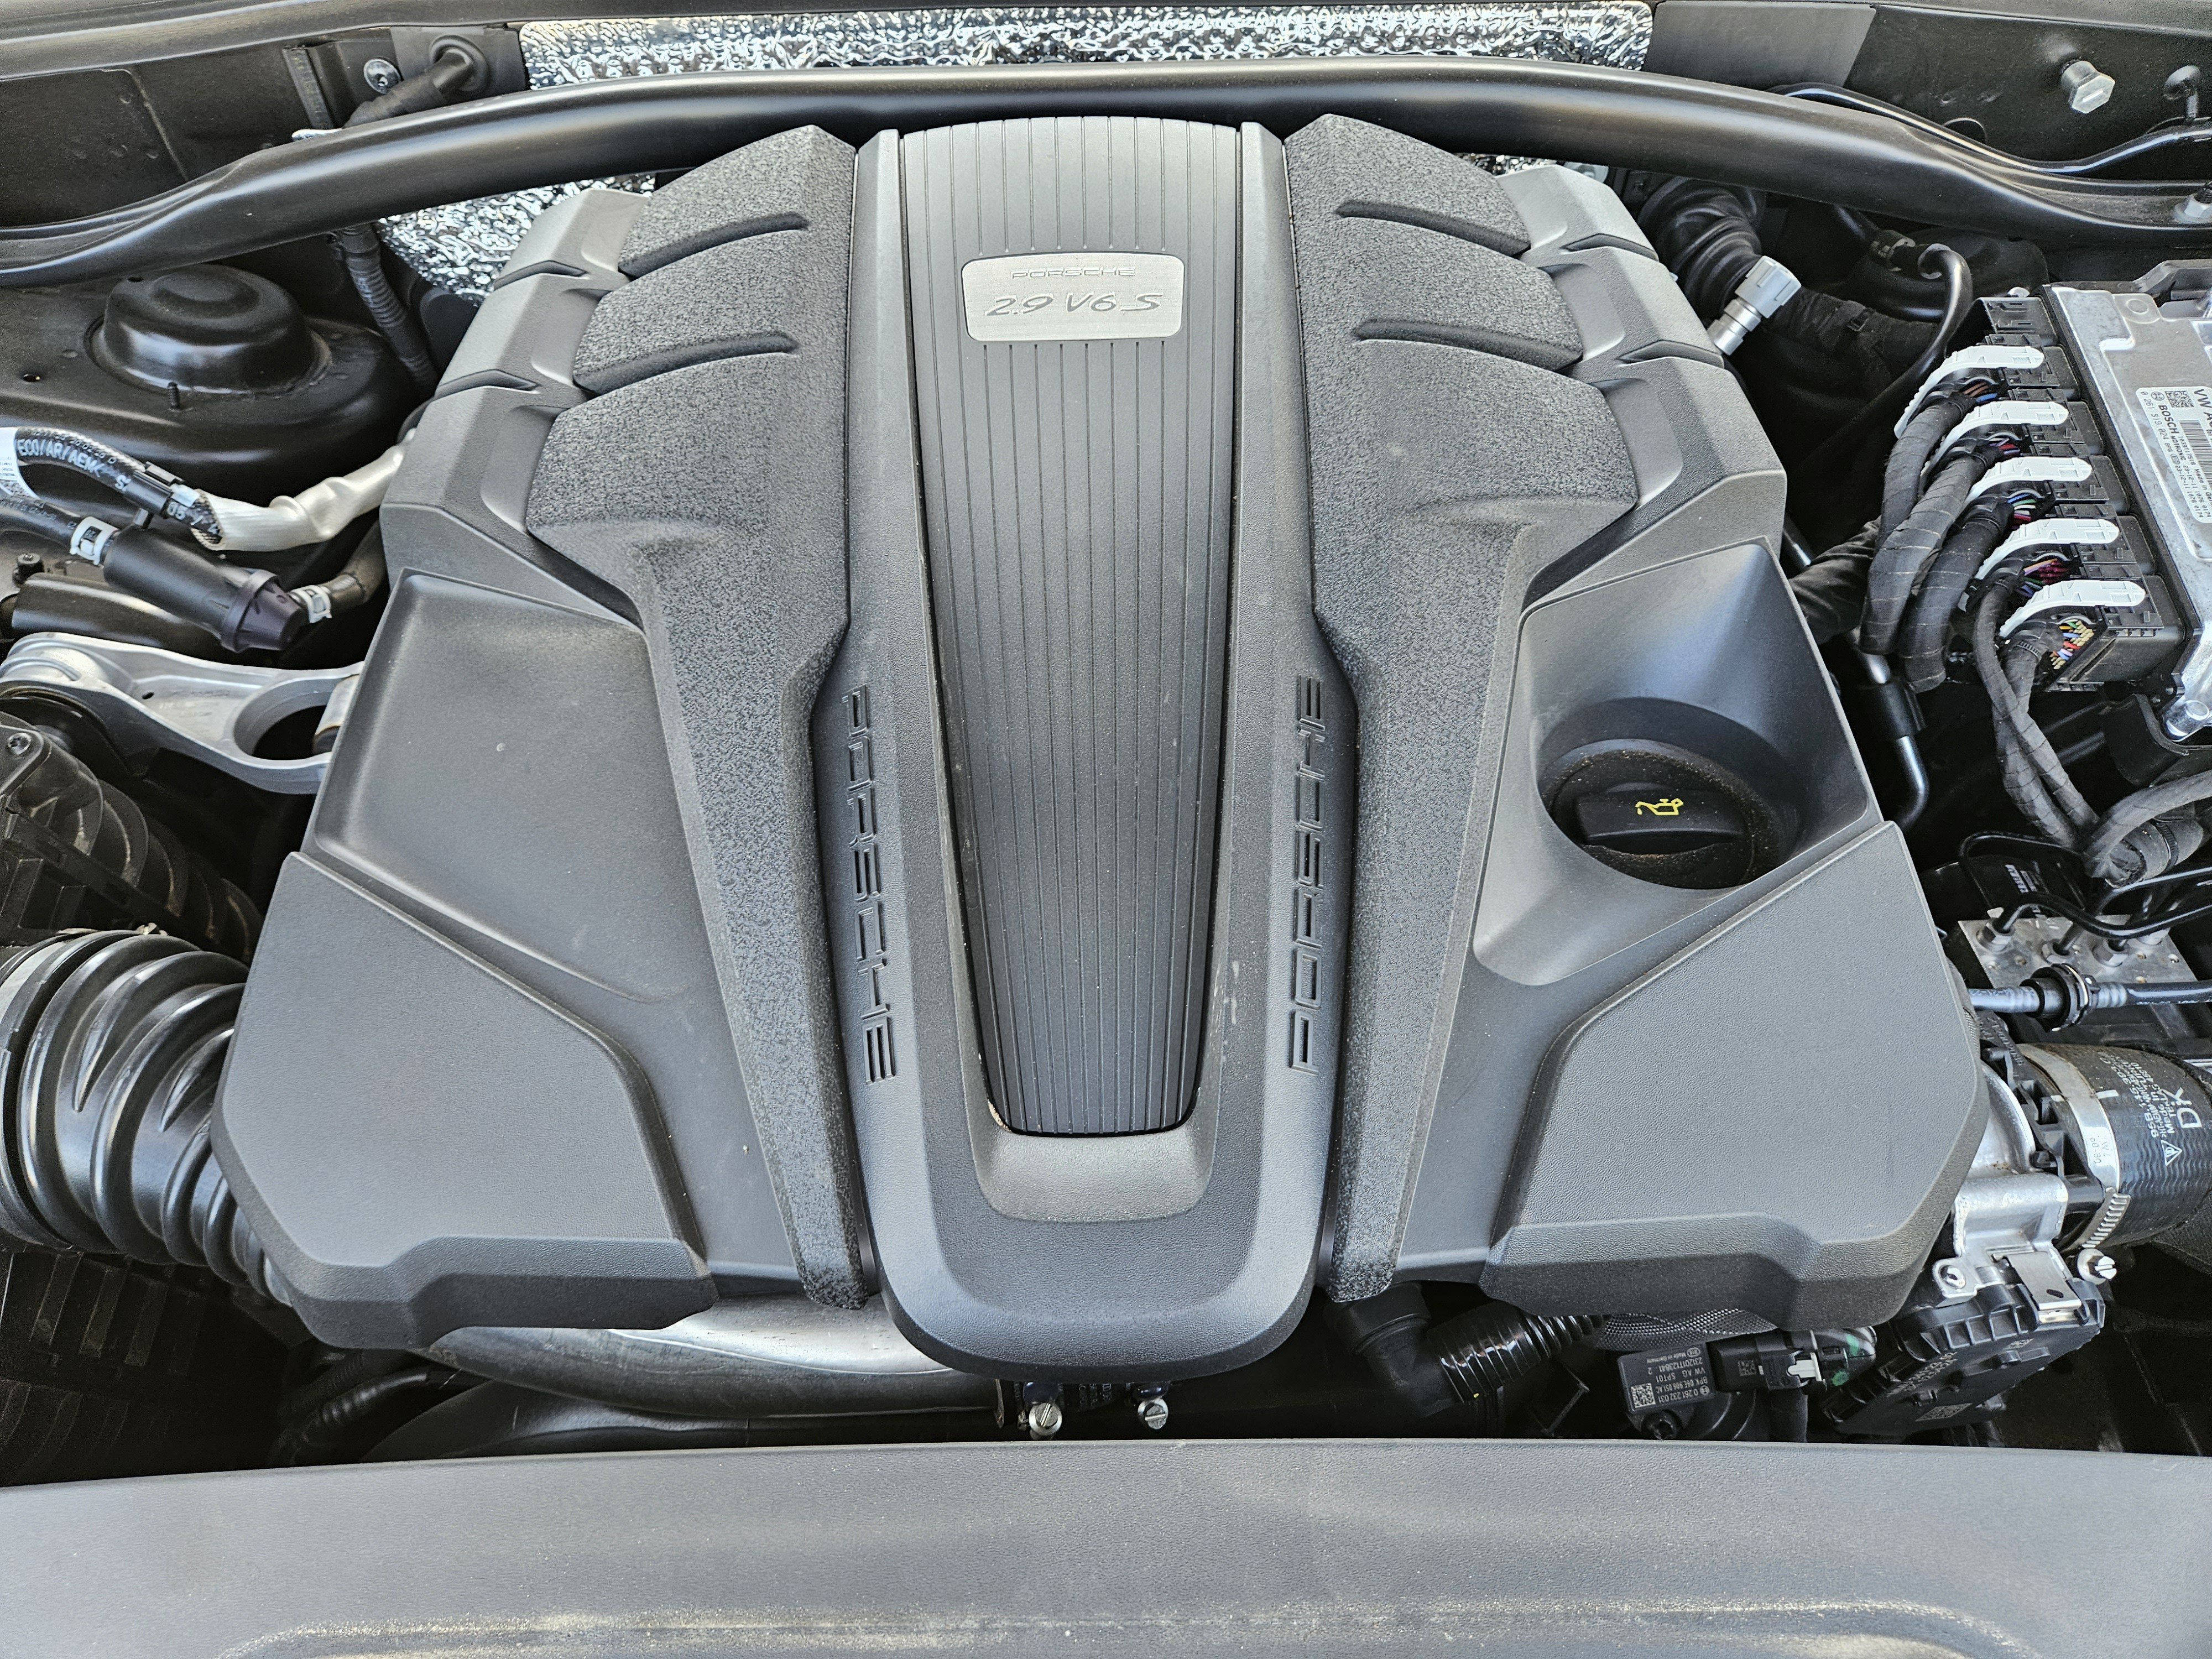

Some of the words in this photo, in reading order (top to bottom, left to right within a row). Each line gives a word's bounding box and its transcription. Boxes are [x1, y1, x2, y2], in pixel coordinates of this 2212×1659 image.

[1011, 267, 1135, 279] PORSCHE
[985, 293, 1054, 316] 2.9
[1066, 292, 1117, 312] V6
[1119, 293, 1164, 311] S
[2158, 405, 2179, 434] BOSCH
[2171, 435, 2187, 461] MOTRONIC
[2194, 468, 2204, 484] Made
[1290, 674, 1326, 1072] PORSCHE
[842, 685, 896, 1086] PORSCHE
[2162, 1087, 2203, 1129] DK
[1647, 1367, 1653, 1375] 2
[1656, 1371, 1676, 1383] SPT01
[1682, 1369, 1692, 1378] AG
[1695, 1376, 1708, 1385] BPK
[1658, 1394, 1670, 1404] 031
[1670, 1391, 1682, 1400] 232
[1682, 1389, 1693, 1399] 261
